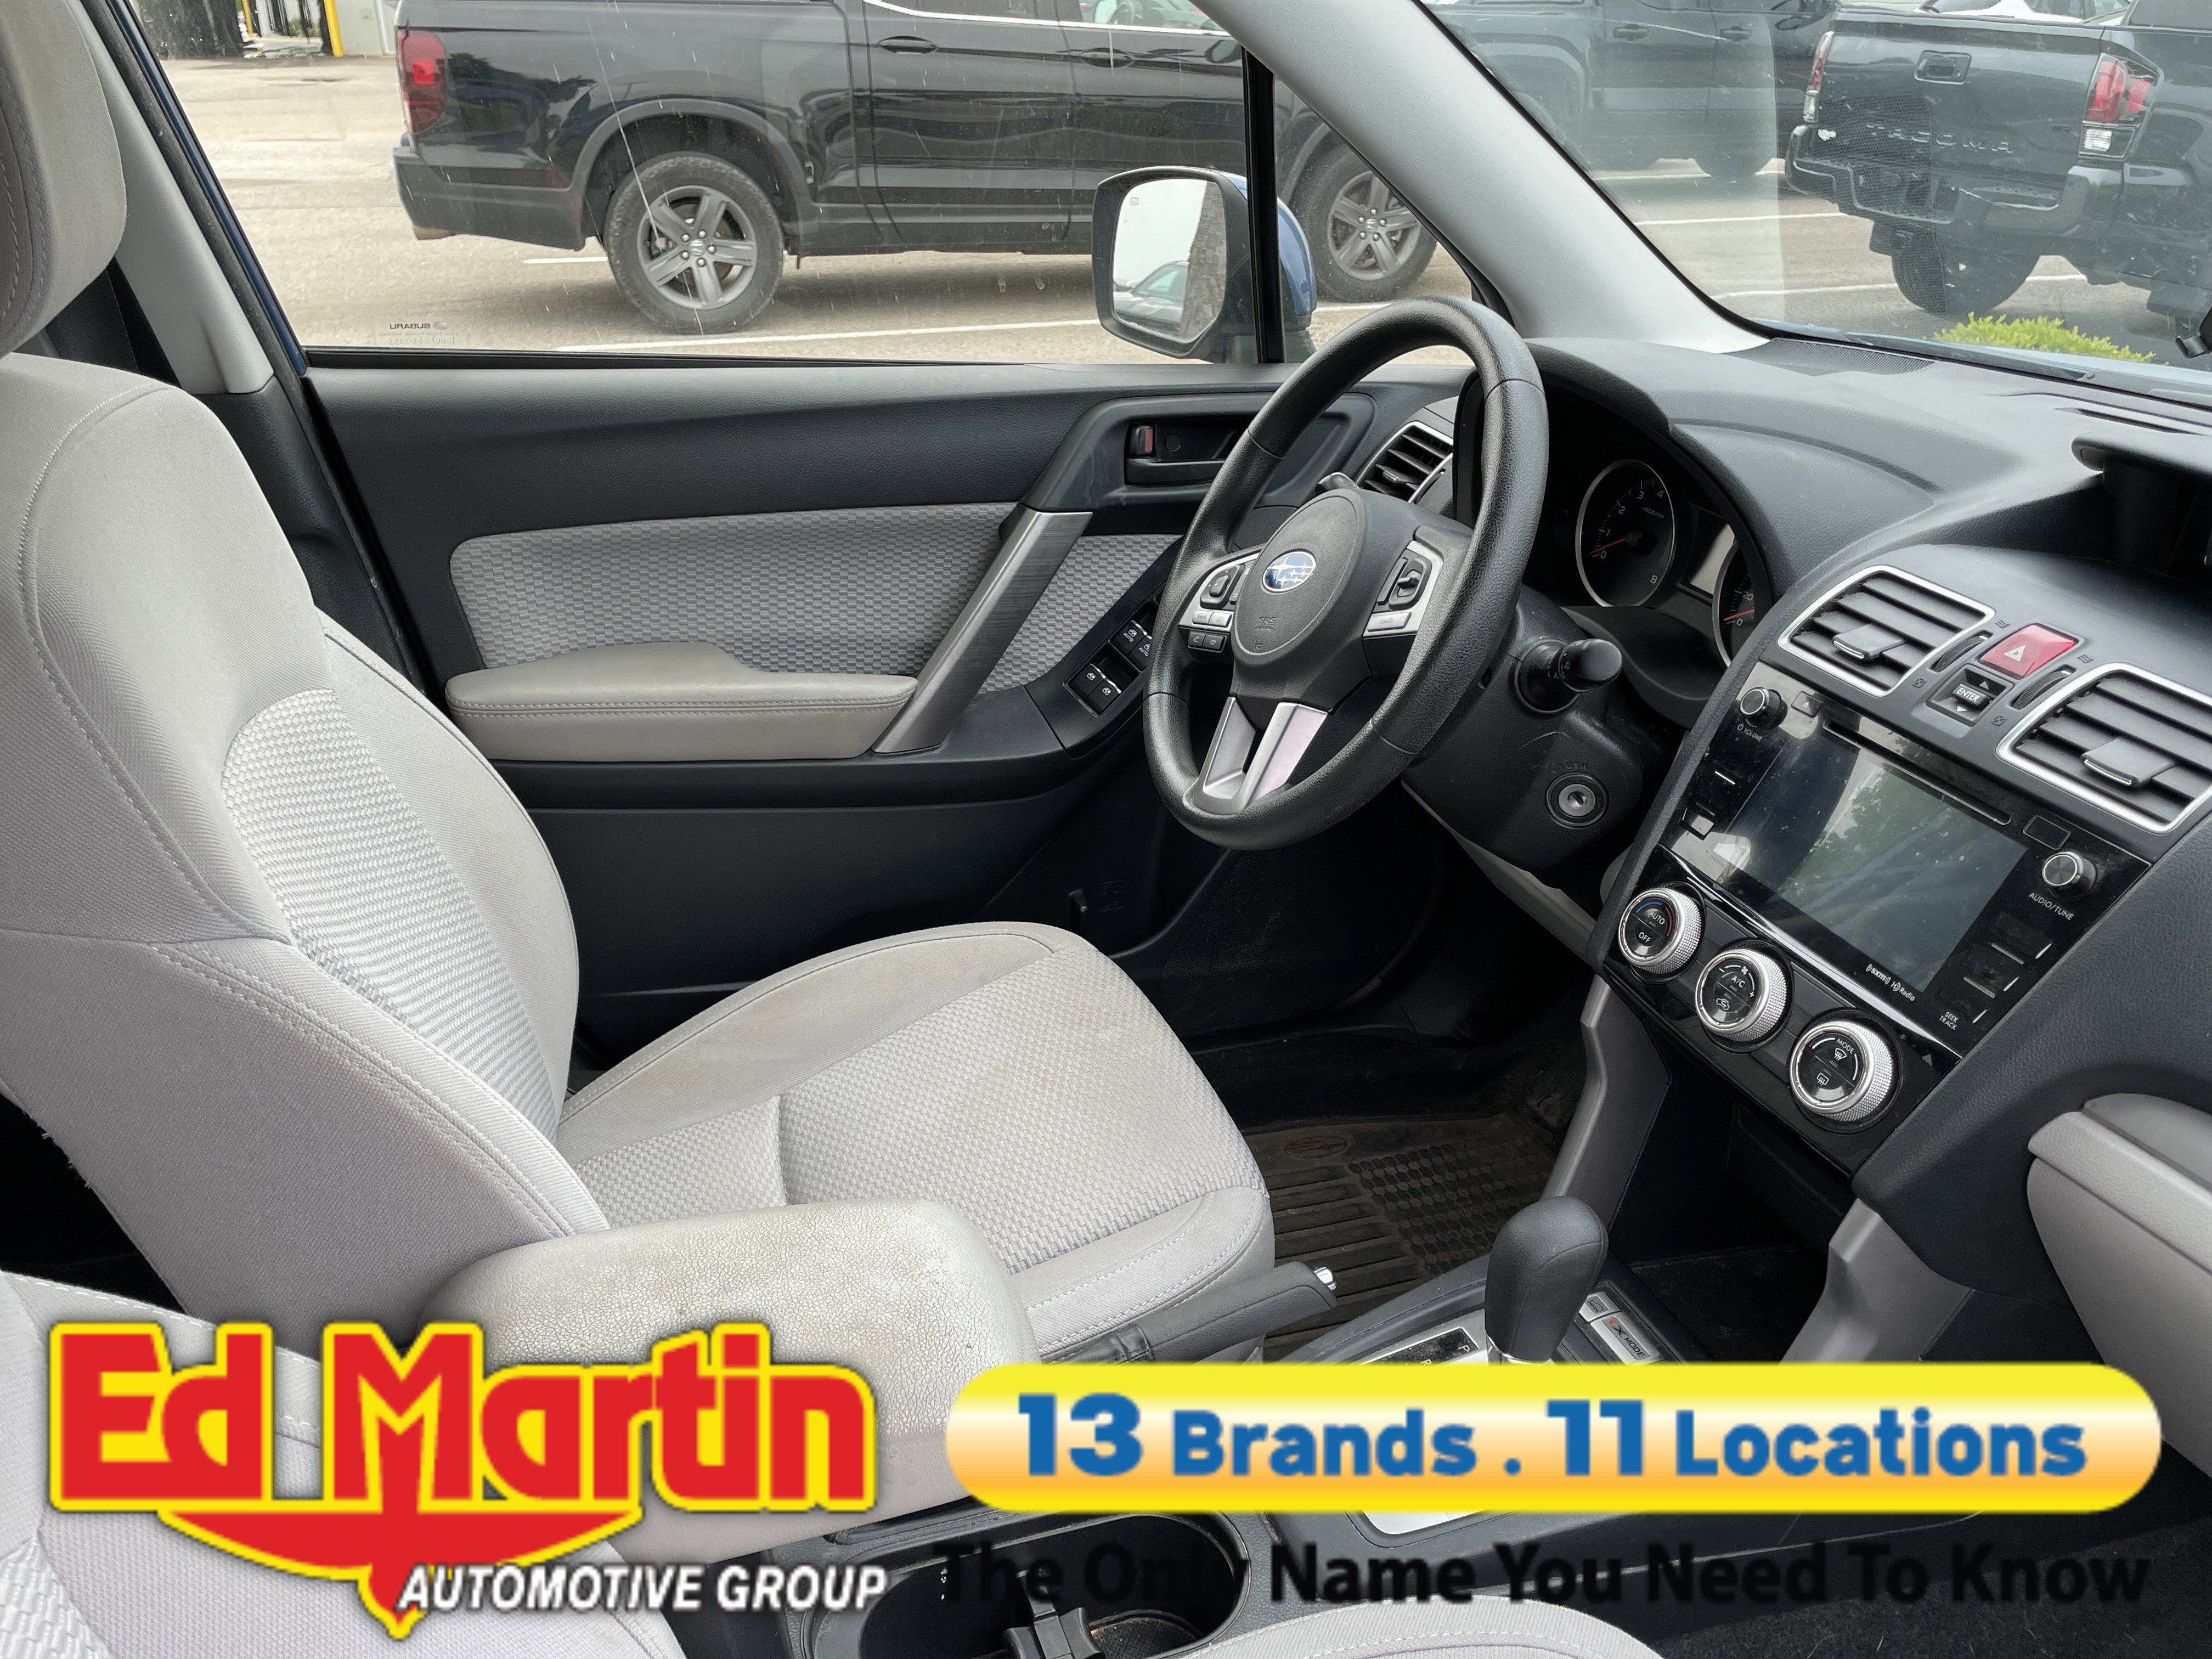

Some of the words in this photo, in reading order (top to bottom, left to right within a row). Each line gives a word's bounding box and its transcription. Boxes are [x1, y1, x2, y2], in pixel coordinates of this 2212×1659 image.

[1637, 490, 1644, 500] 3
[1618, 505, 1626, 515] 2
[1650, 575, 1658, 584] 8
[1742, 591, 1753, 601] 20
[1123, 633, 1134, 642] AUTO
[1138, 647, 1149, 657] AUTO
[1956, 687, 1980, 702] ENTER
[1745, 727, 1763, 742] VOLUME
[2029, 893, 2074, 920] AUDIO/TUNE
[1648, 912, 1665, 924] AUTO
[1639, 932, 1651, 943] OFF
[1731, 976, 1746, 988] A/C
[1899, 987, 1915, 1001] Radio
[1939, 1015, 1957, 1031] TRACK
[1944, 1012, 1959, 1023] SEEK
[1836, 1039, 1854, 1054] MODE
[1458, 1345, 1470, 1353] P
[1624, 1338, 1645, 1357] MODE
